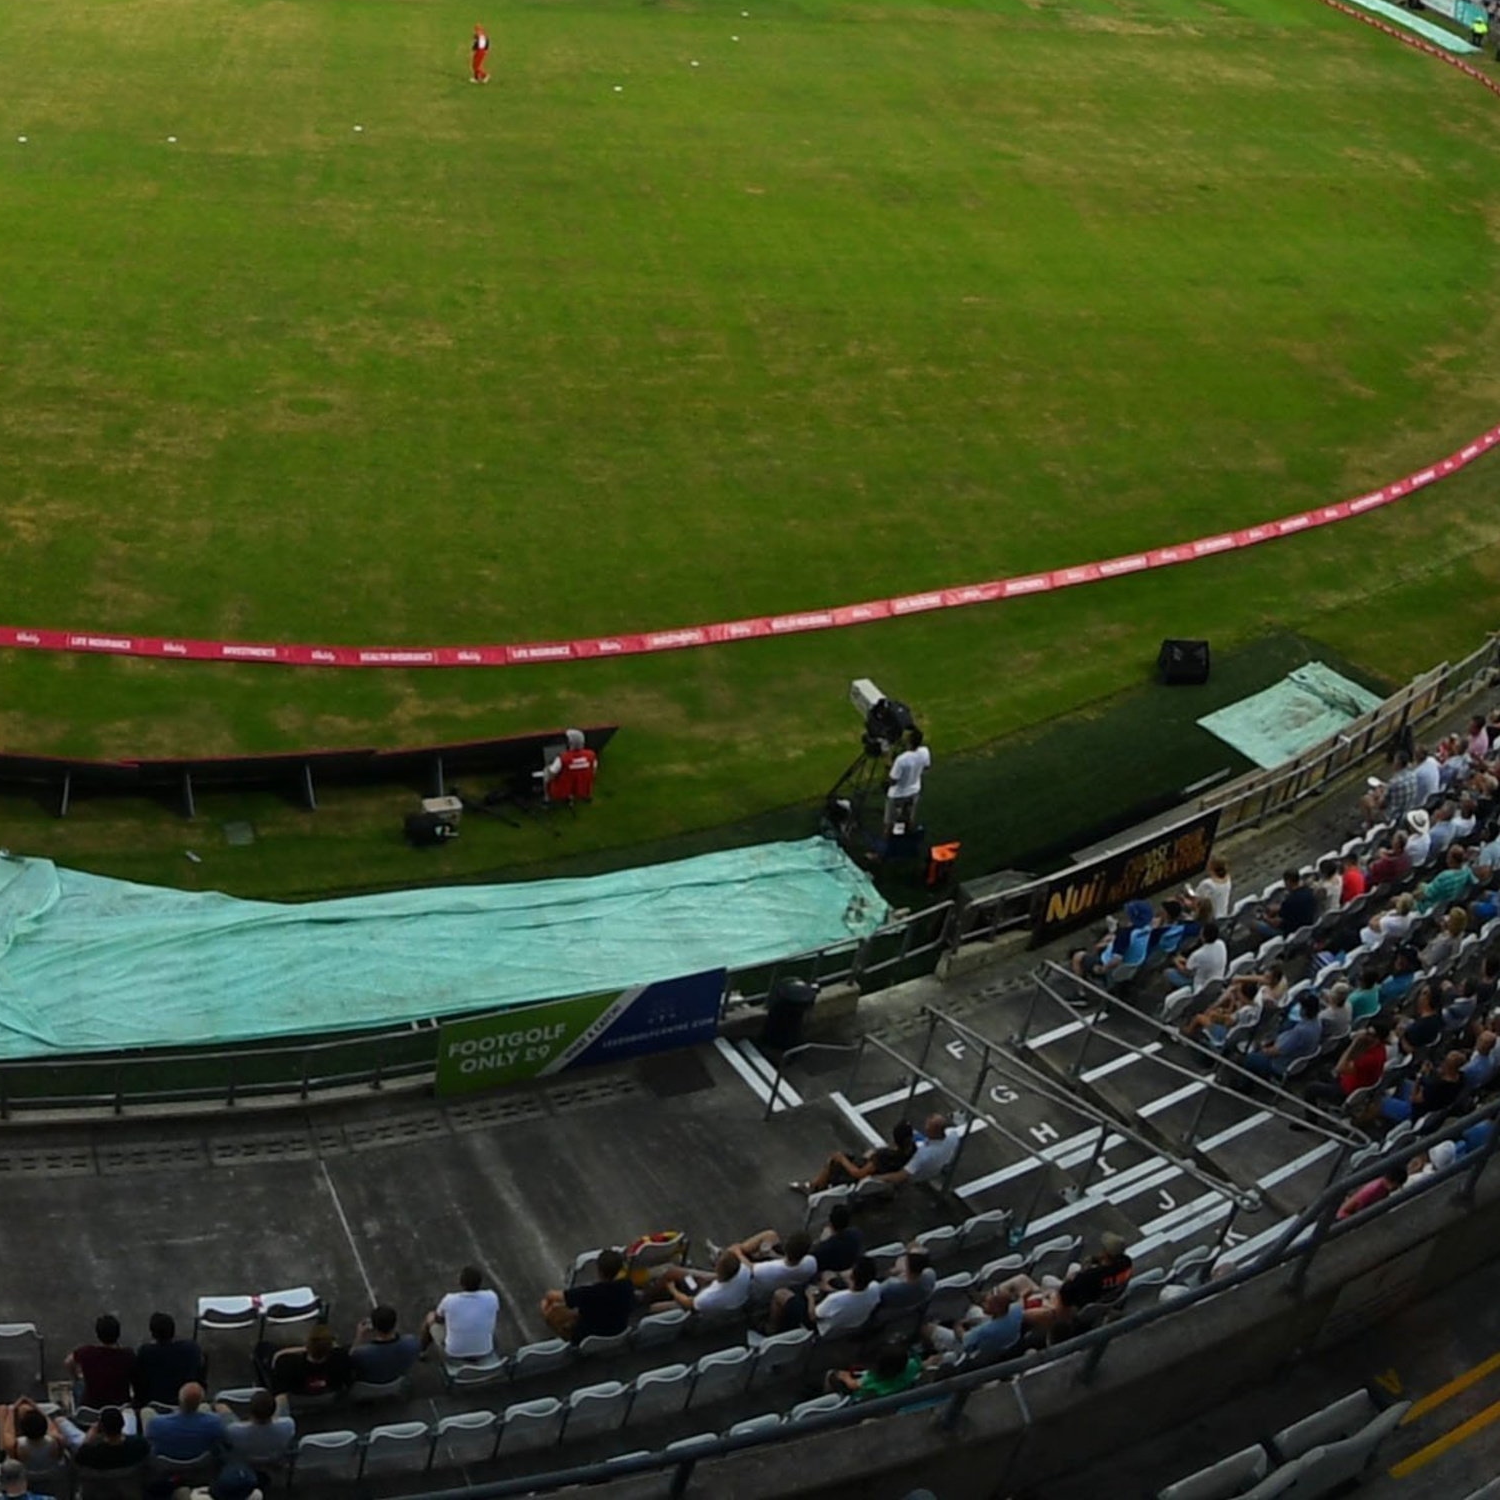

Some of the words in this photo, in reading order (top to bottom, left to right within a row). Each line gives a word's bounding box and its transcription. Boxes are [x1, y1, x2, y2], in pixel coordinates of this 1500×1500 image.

[71, 636, 87, 647] LIFE
[88, 637, 131, 650] INSURANCE
[360, 651, 390, 662] HEALTH
[390, 652, 433, 662] INSURANCE
[449, 1022, 567, 1058] FOOTGOLF
[945, 1038, 967, 1061] F
[459, 1052, 516, 1074] ONLY
[523, 1044, 551, 1063] £9
[989, 1084, 1019, 1105] G
[1029, 1121, 1059, 1144] H
[1097, 1156, 1117, 1177] I
[1158, 1188, 1177, 1211] J
